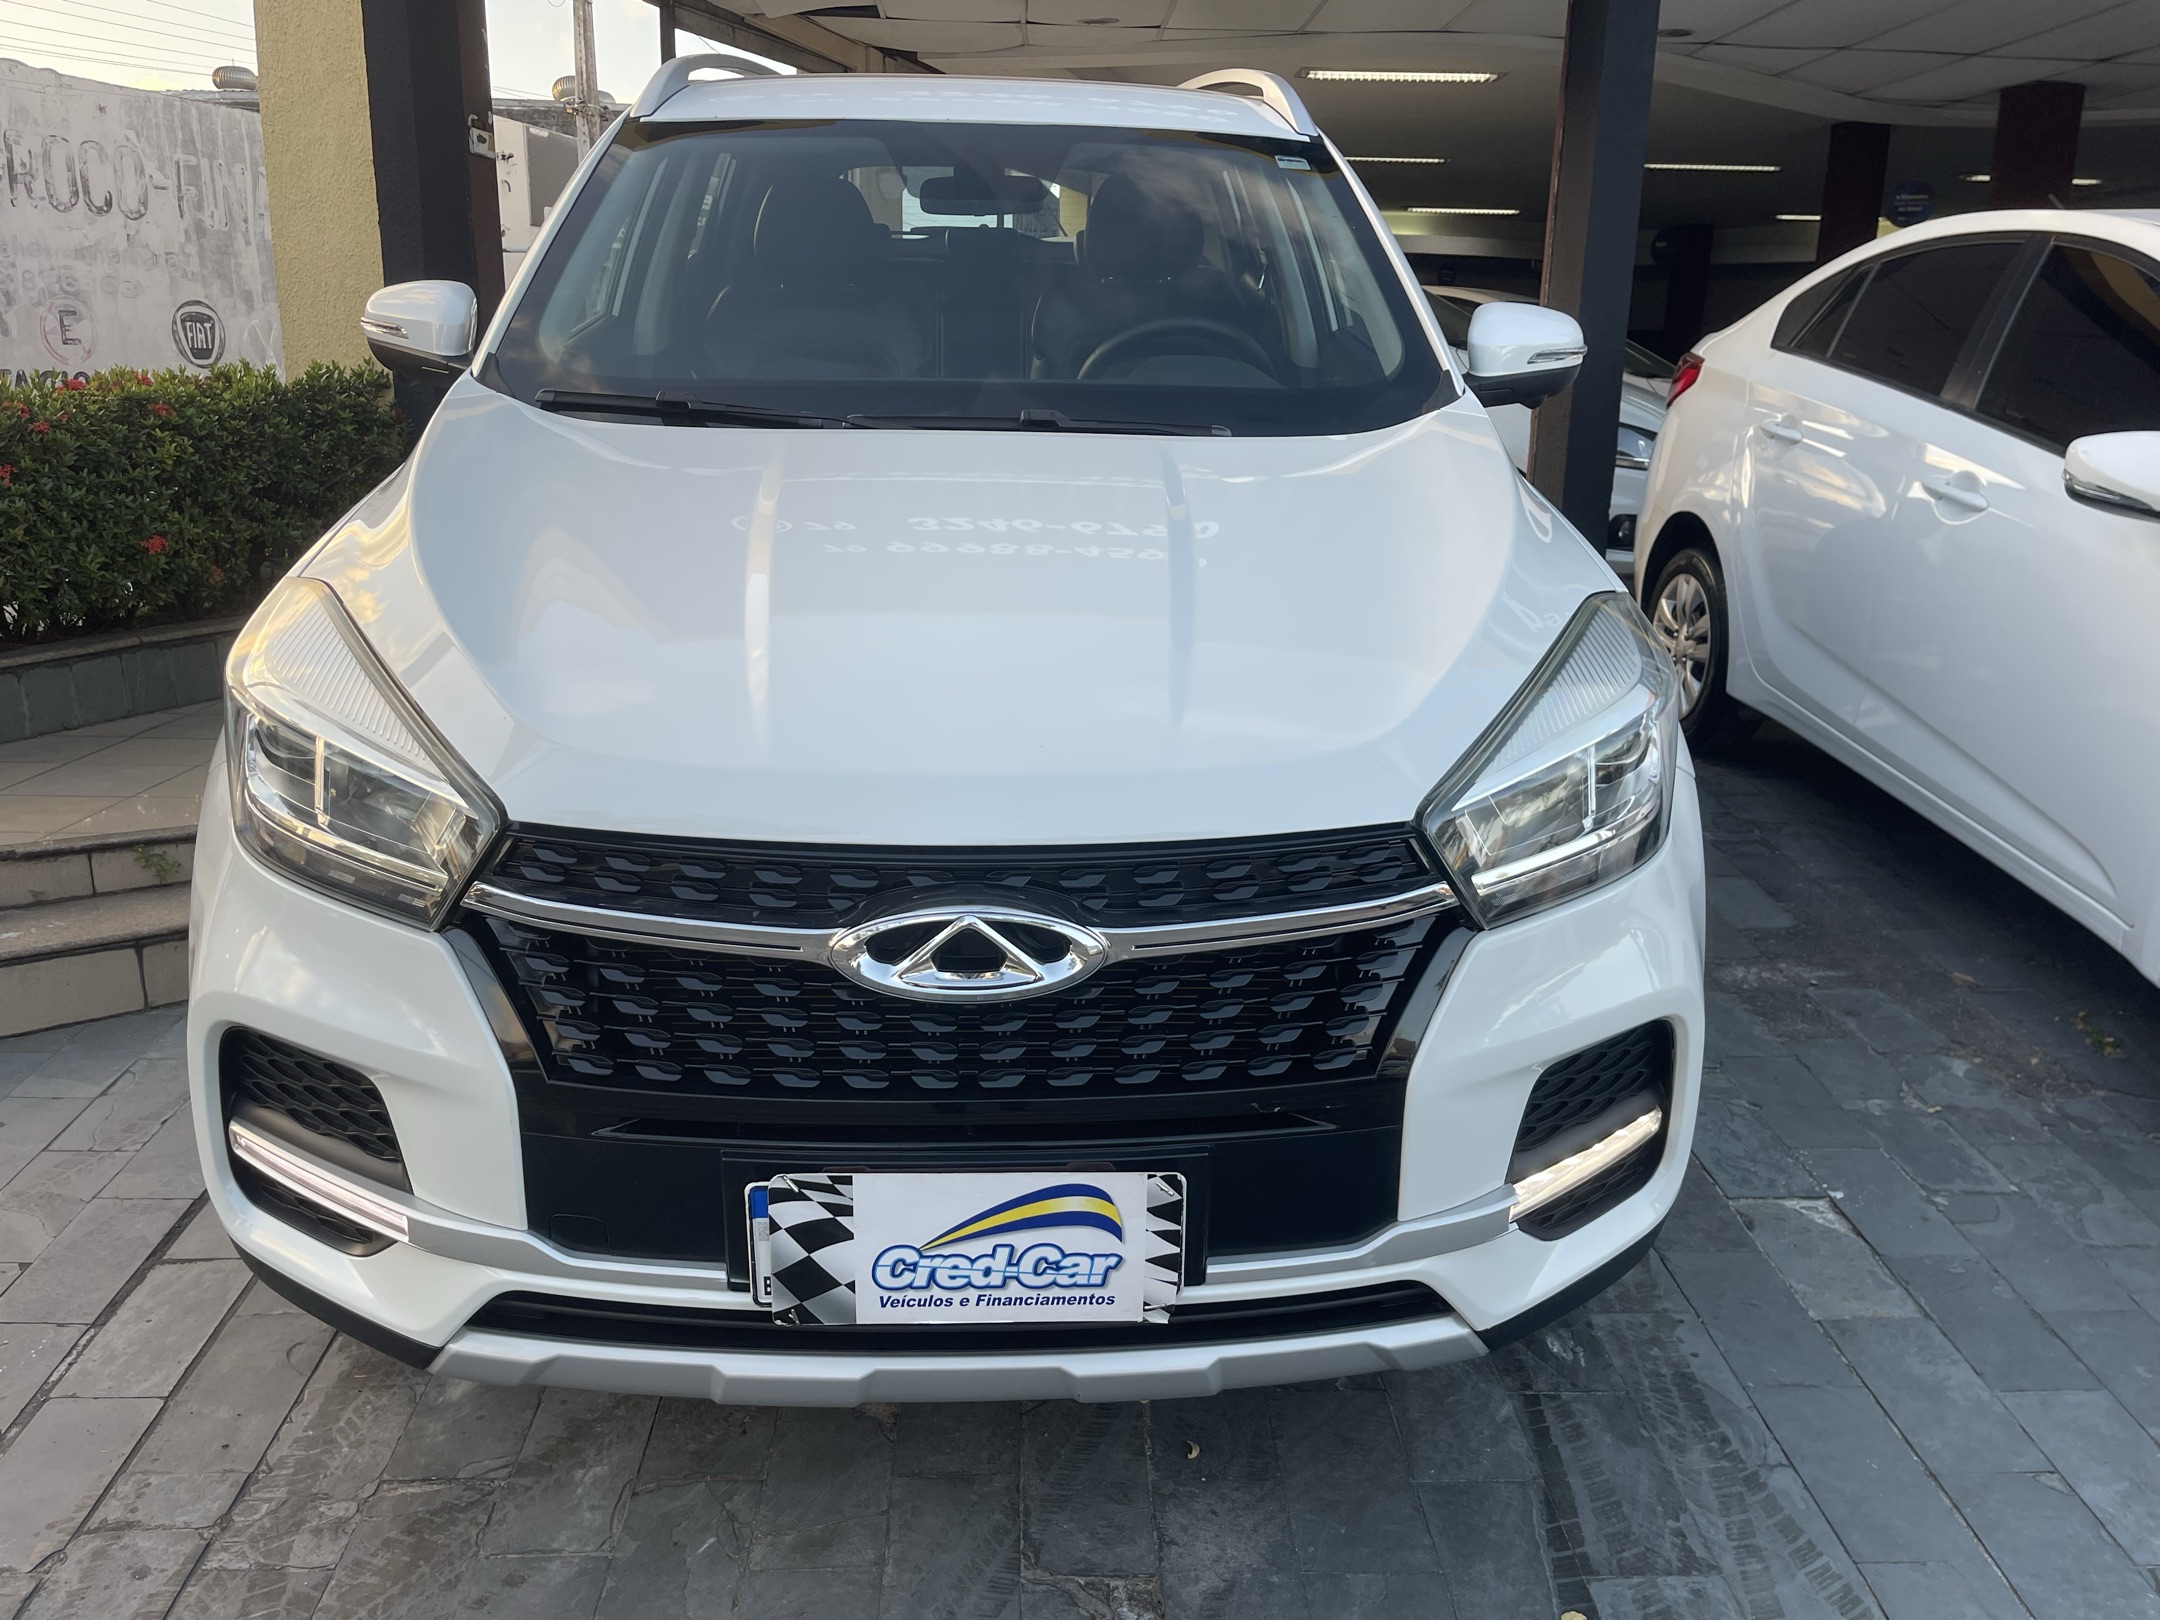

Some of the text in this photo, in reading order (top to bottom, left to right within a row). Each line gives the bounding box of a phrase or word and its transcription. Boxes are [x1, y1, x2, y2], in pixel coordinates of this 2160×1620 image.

[185, 321, 213, 349] FIAT
[872, 1243, 1123, 1291] Cred-Car
[879, 1292, 1116, 1309] Veículos e Financiamentos
